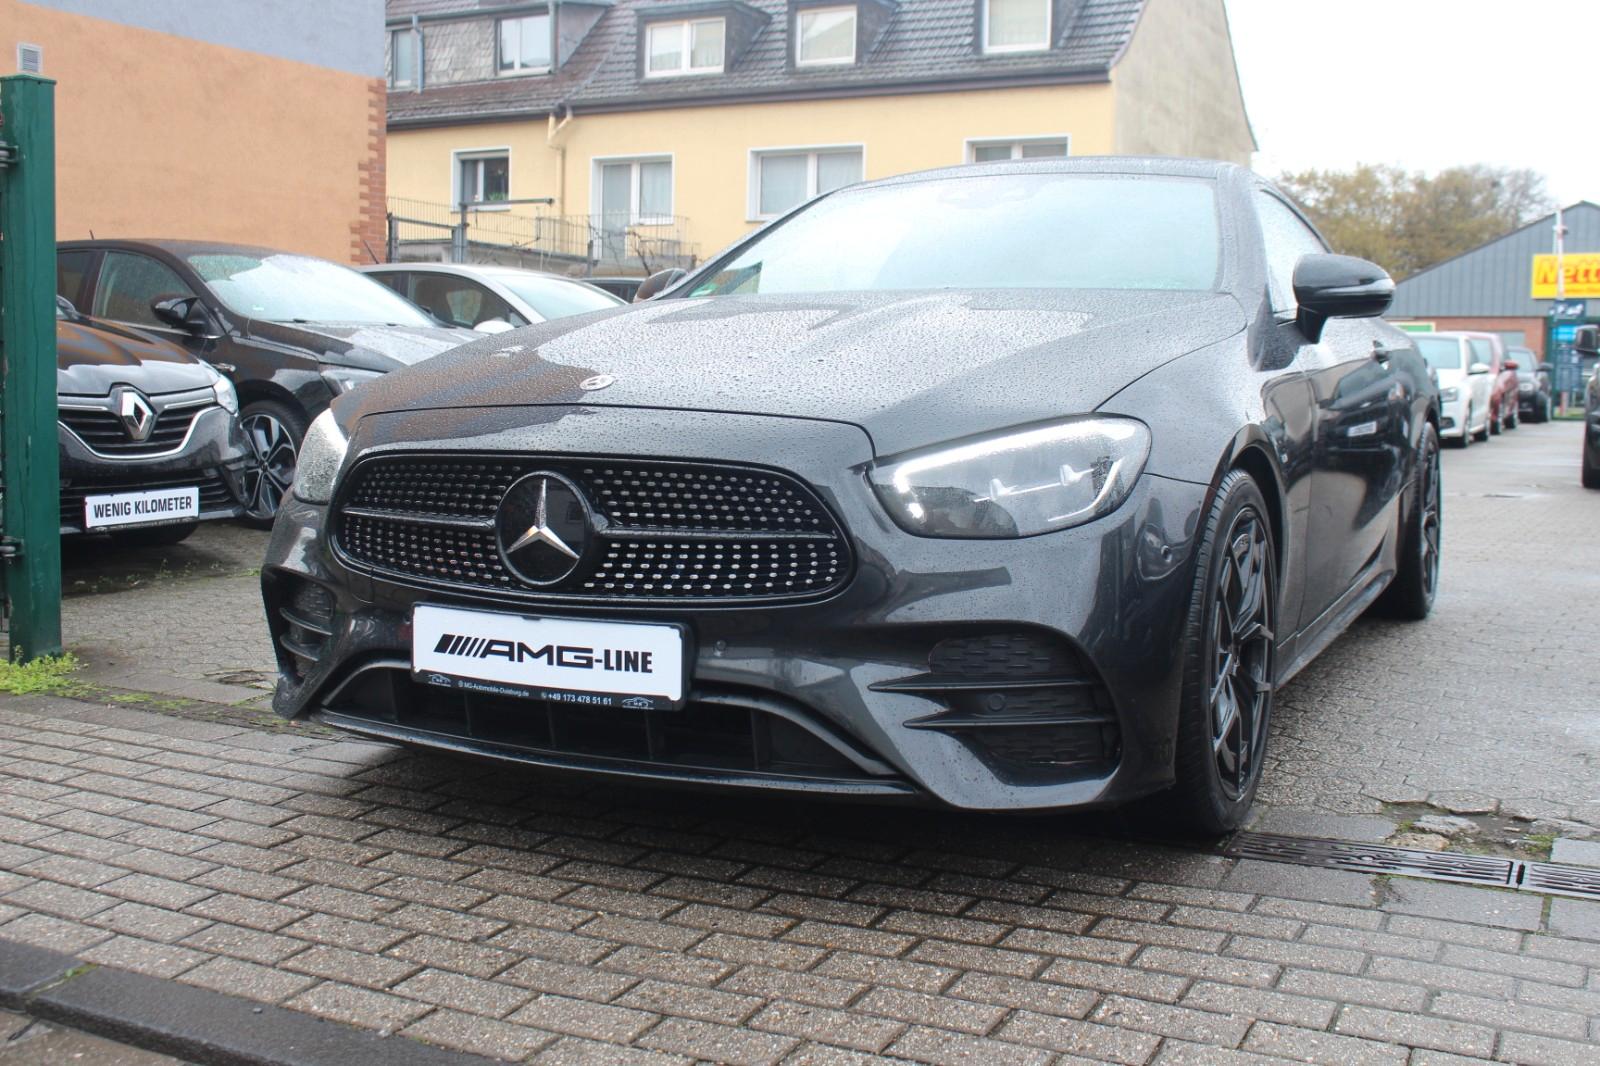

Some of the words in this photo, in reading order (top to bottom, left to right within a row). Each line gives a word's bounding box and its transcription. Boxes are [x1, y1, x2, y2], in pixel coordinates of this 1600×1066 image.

[94, 502, 131, 518] WENIG
[134, 496, 192, 514] KILOMETER
[548, 692, 561, 701] +49
[563, 693, 576, 703] 173
[578, 695, 591, 704] 478
[592, 696, 601, 705] 51
[603, 697, 612, 705] 61
